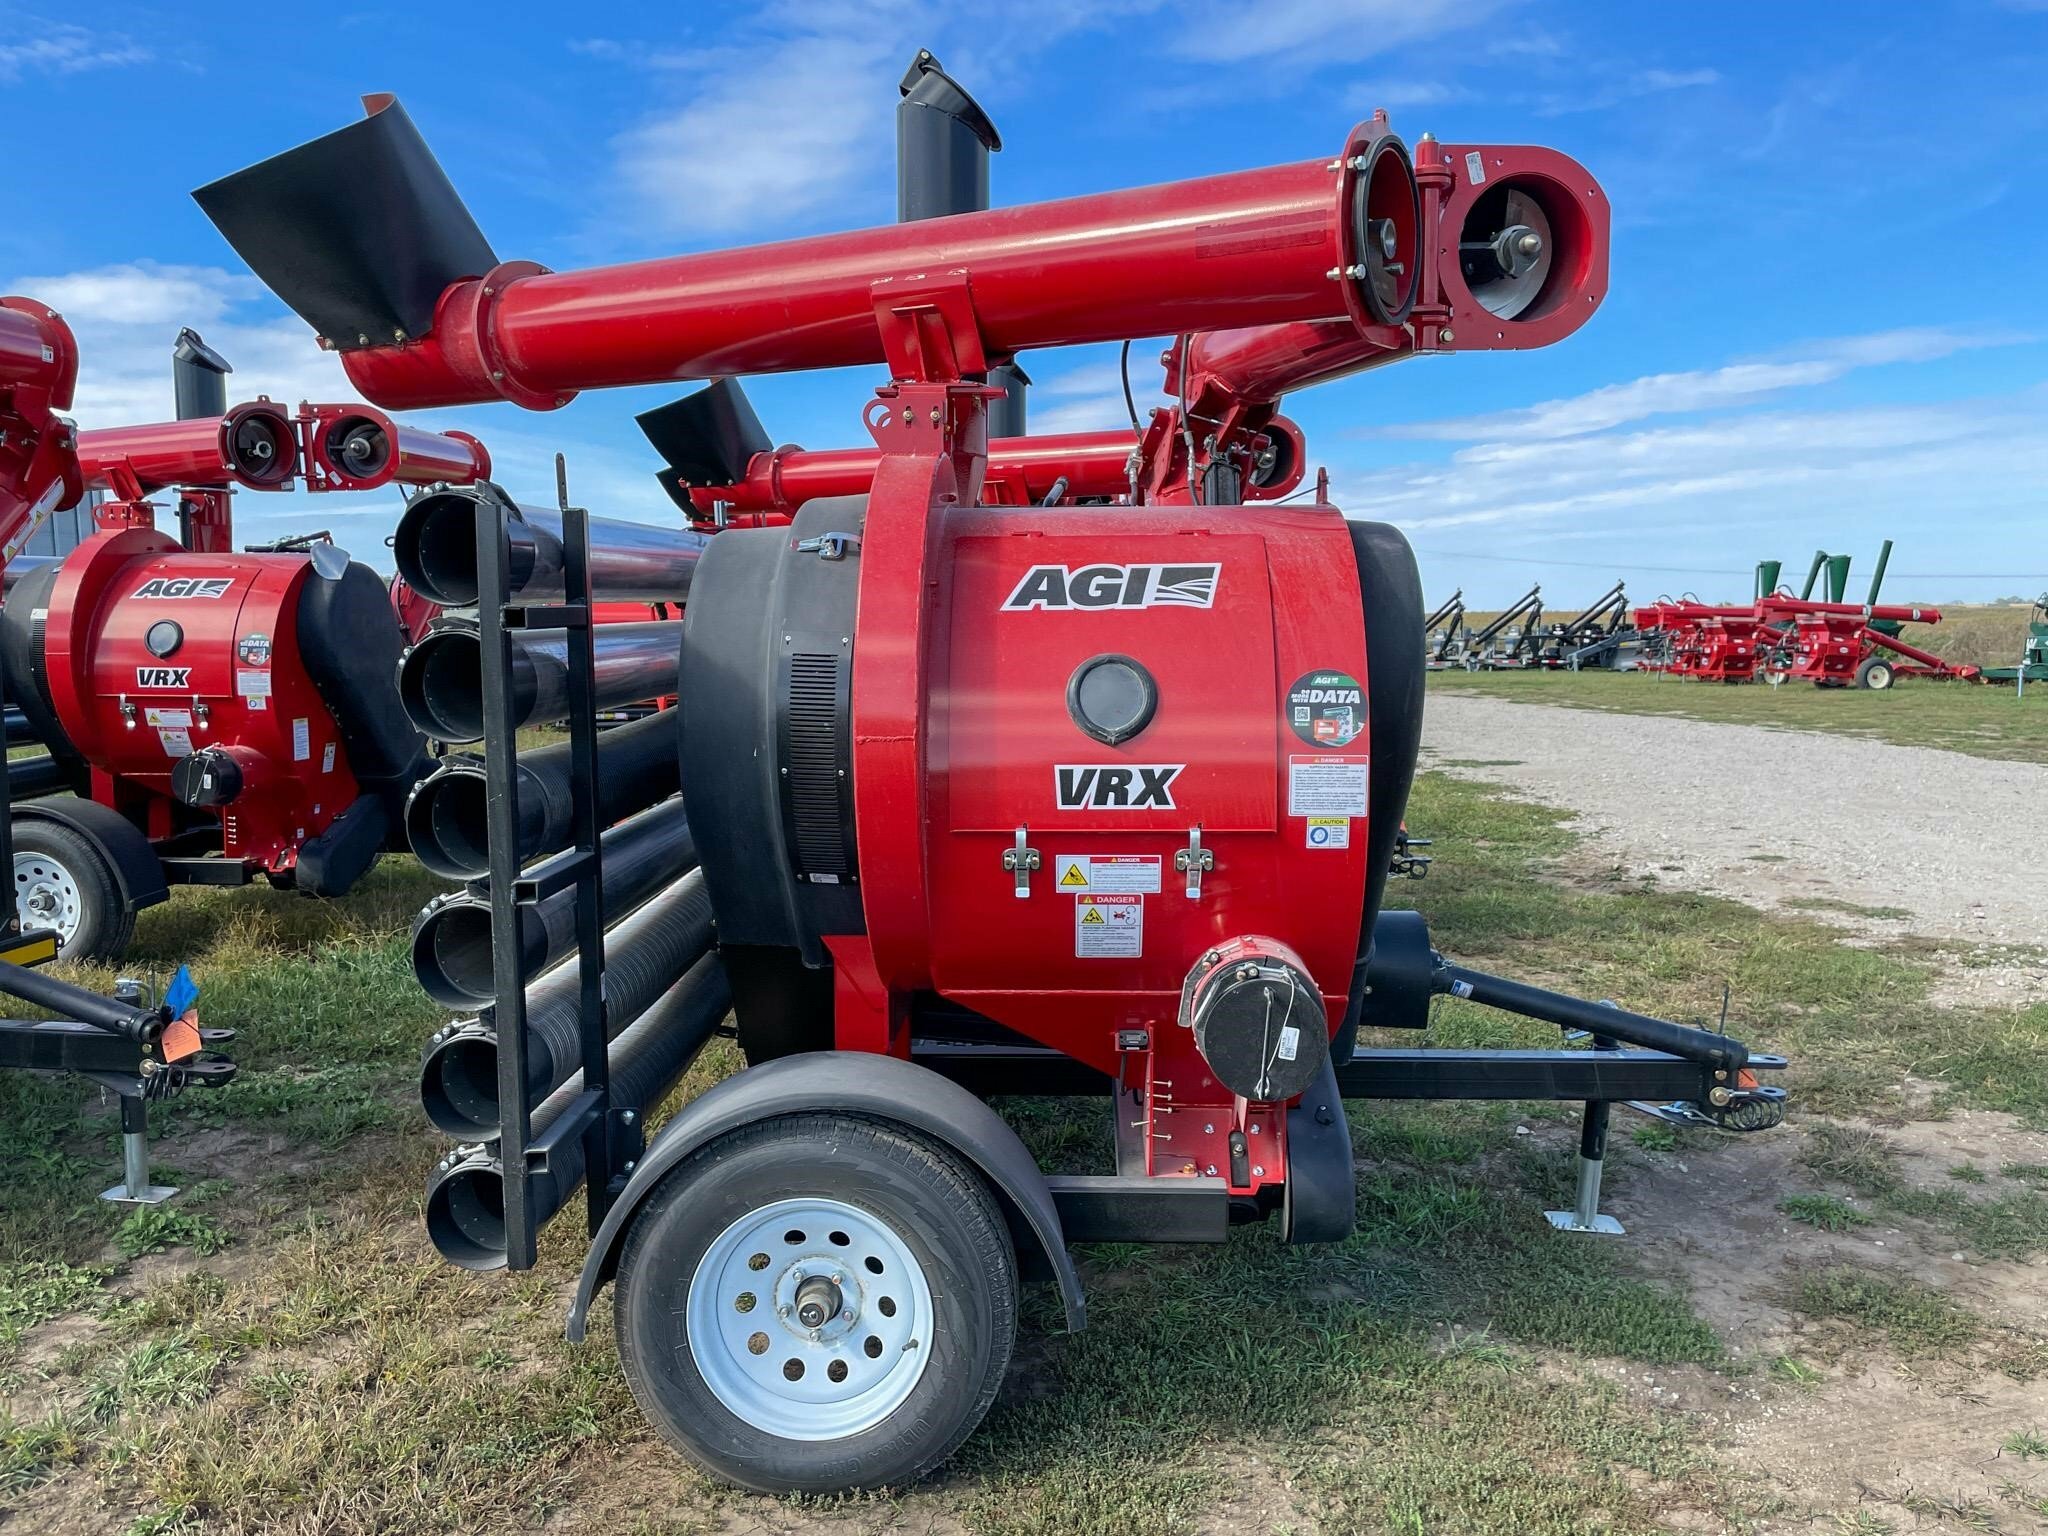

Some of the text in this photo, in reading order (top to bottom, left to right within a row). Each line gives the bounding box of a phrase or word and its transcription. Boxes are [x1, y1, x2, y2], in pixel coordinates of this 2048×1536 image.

[134, 579, 200, 598] AGI
[1008, 567, 1152, 606] AGI
[248, 640, 270, 648] DATA
[138, 668, 189, 687] VRX
[1309, 689, 1361, 704] DATA
[1058, 768, 1179, 806] VRX
[1096, 896, 1136, 904] DANGER
